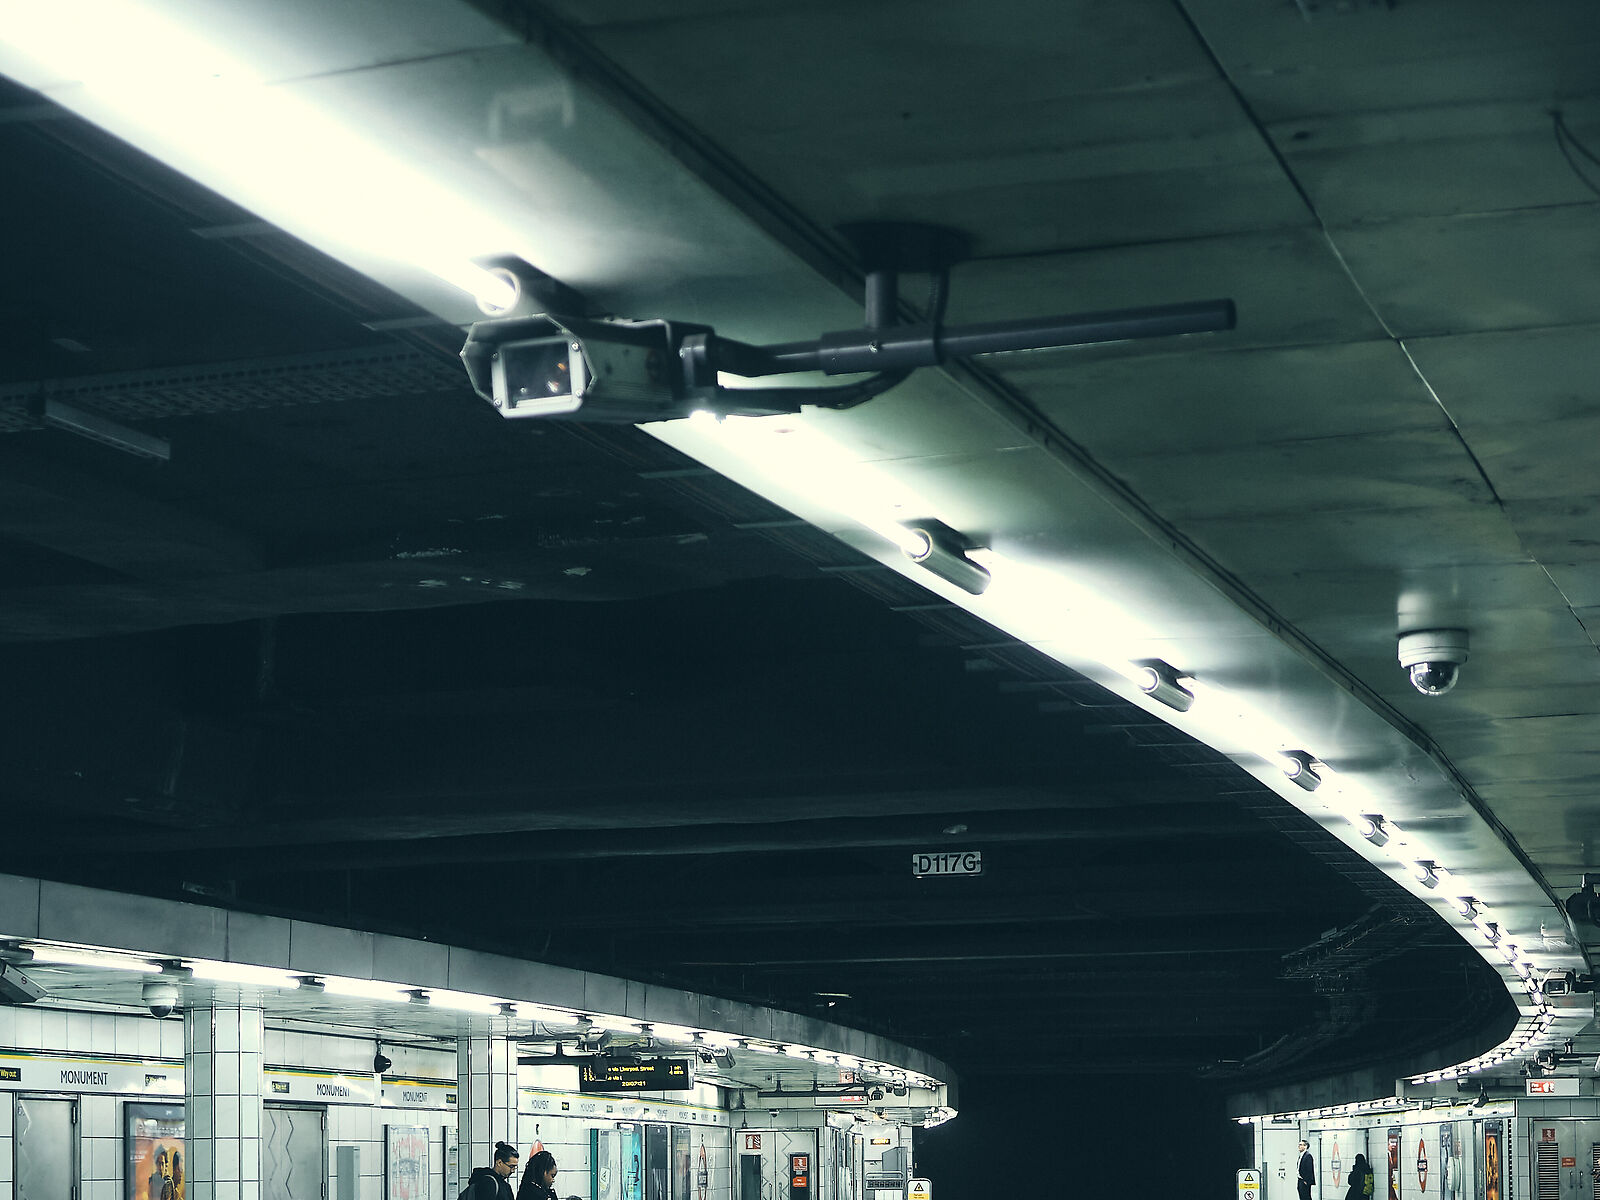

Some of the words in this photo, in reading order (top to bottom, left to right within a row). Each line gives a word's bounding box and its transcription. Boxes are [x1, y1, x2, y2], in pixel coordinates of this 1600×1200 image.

[918, 854, 976, 873] D117G
[60, 1070, 109, 1085] MONUMENT
[316, 1083, 350, 1097] MONUMENT
[402, 1091, 428, 1102] MONUMENT
